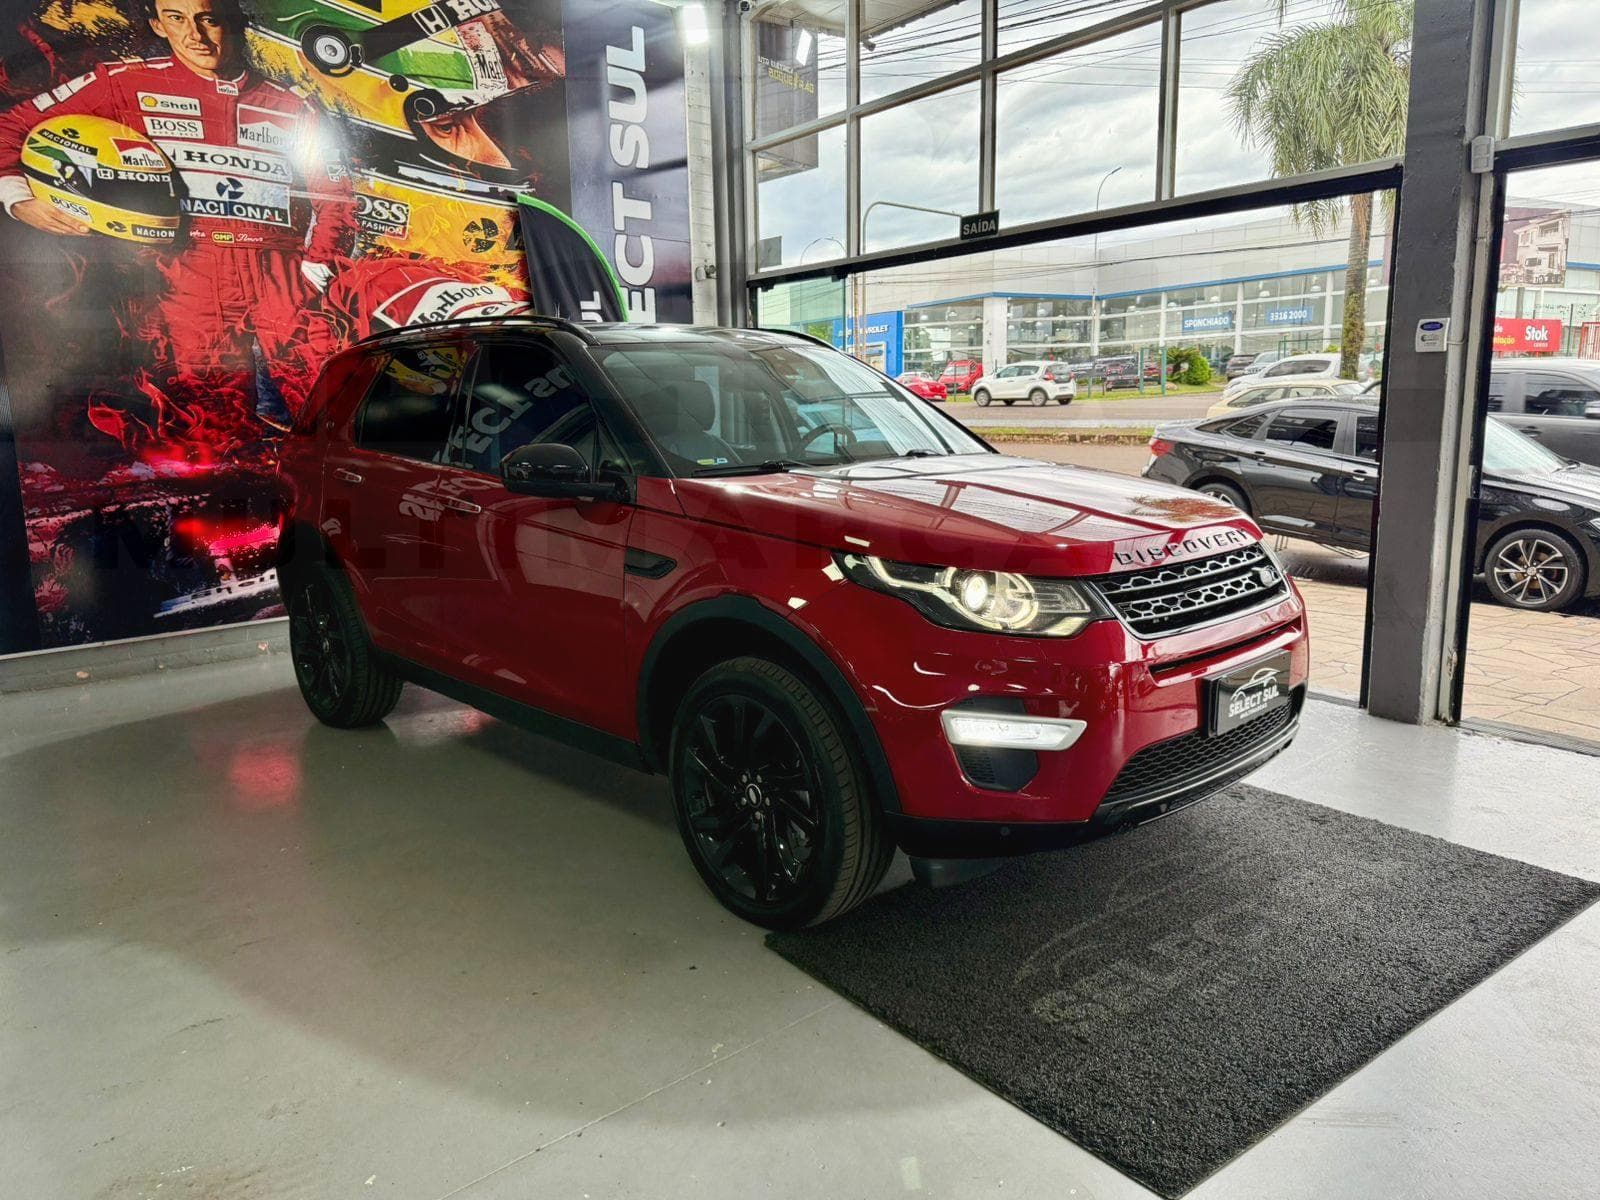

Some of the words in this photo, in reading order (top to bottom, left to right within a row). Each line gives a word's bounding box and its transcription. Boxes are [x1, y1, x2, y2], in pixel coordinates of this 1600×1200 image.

[446, 0, 501, 21] HO
[160, 100, 198, 111] Shell
[606, 25, 650, 169] SUL
[150, 118, 199, 133] BOSS
[42, 130, 92, 154] NACIONAL
[184, 150, 288, 176] HONDA
[51, 195, 89, 217] BOSS
[136, 228, 175, 238] NACION
[362, 221, 403, 236] FASHION
[963, 219, 996, 236] SAÍDA
[1184, 316, 1229, 328] SPONCHIADO
[1288, 310, 1308, 320] 2000
[1524, 325, 1549, 341] Stok
[1114, 528, 1249, 566] DISCOVERY
[1228, 691, 1263, 718] SELECT
[1262, 684, 1280, 702] SUL
